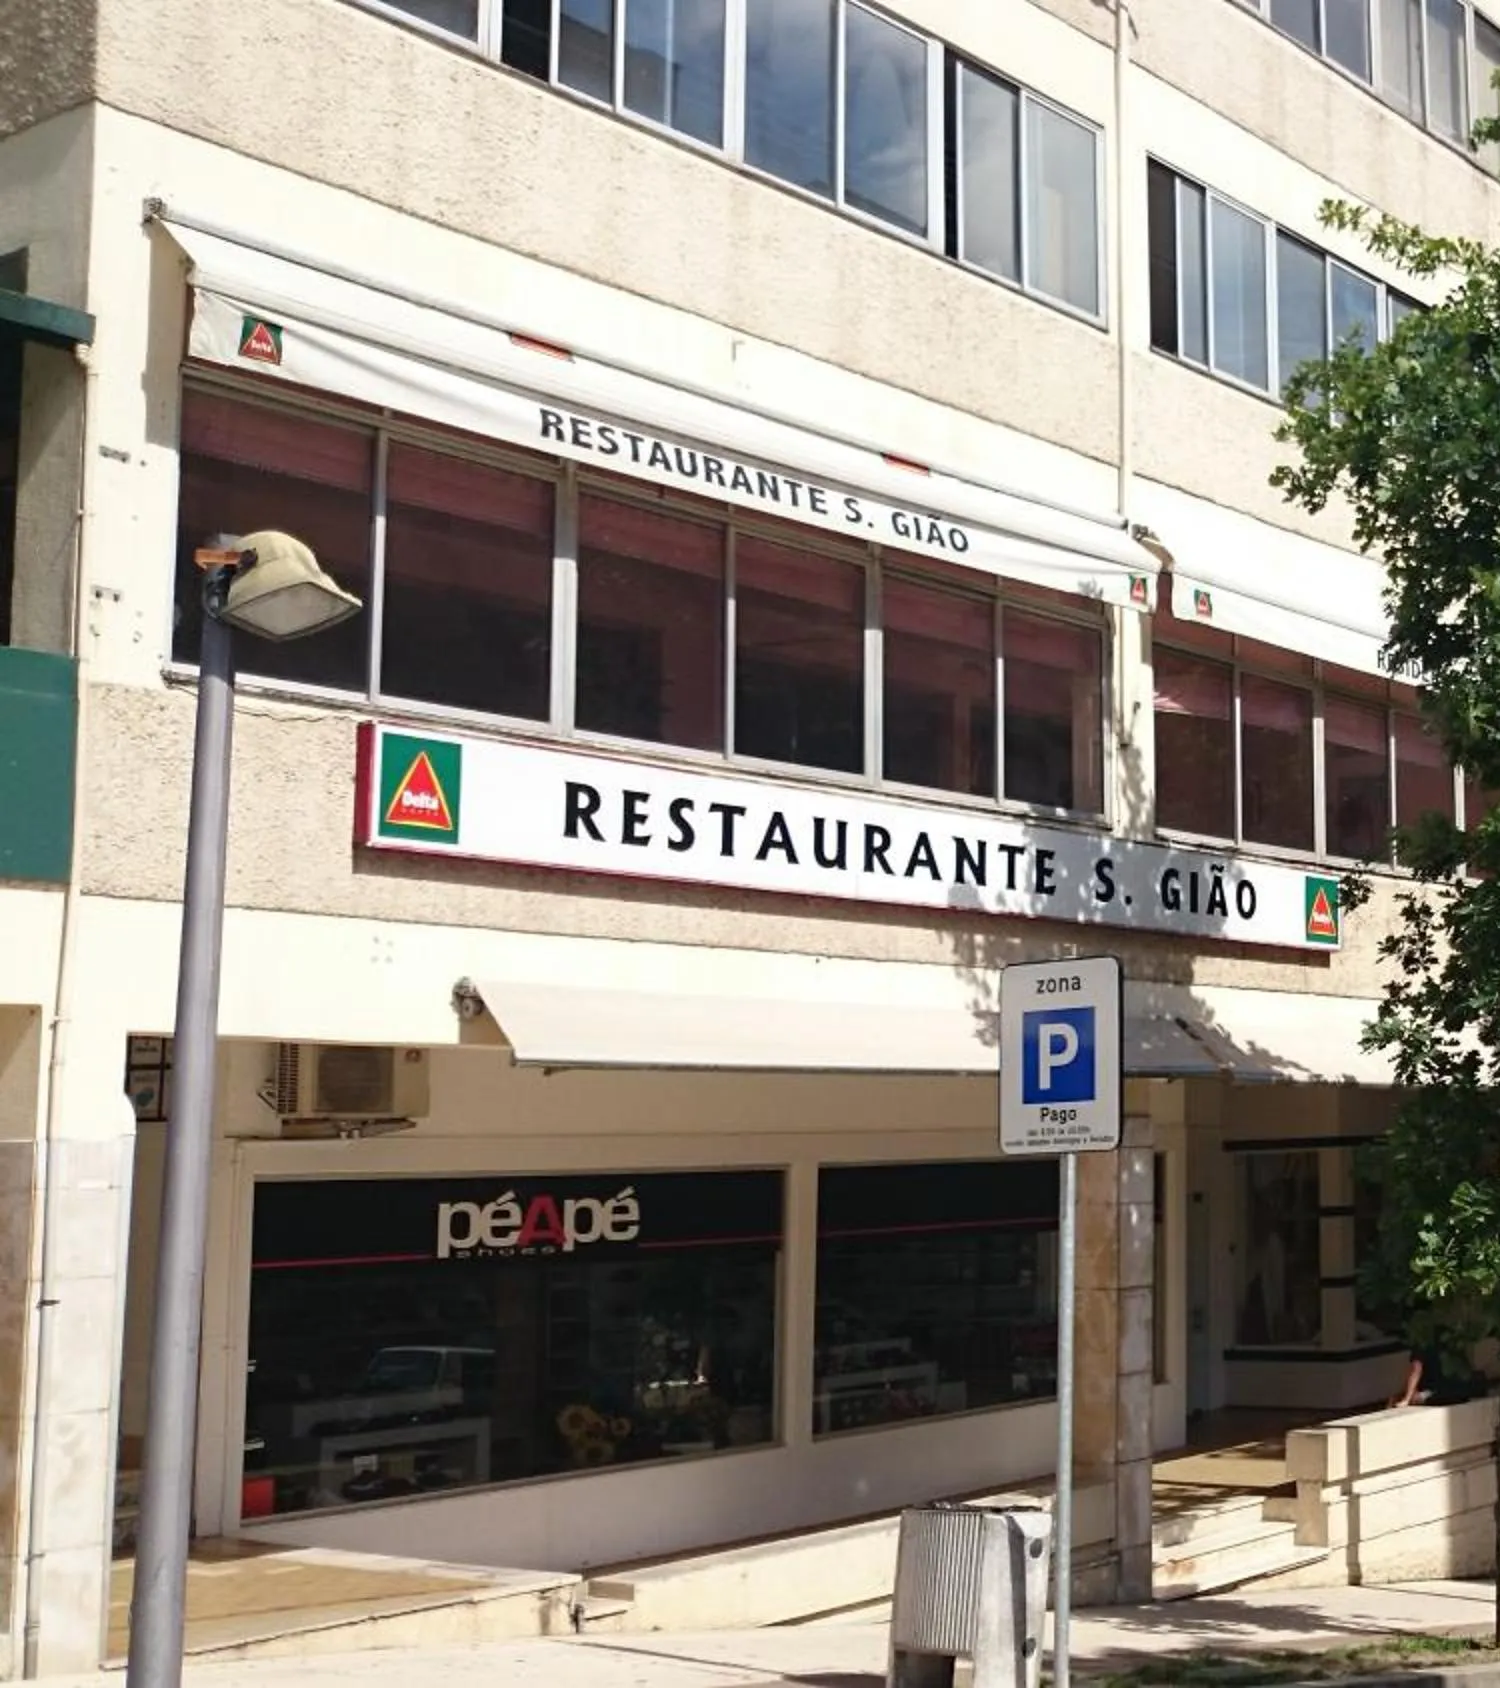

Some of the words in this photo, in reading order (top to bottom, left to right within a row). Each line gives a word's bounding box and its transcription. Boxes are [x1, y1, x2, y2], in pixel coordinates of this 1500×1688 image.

[539, 408, 829, 515] RESTAURANTE
[843, 497, 875, 528] S.
[891, 510, 969, 553] GIÃO
[562, 781, 1057, 896] RESTAURANTE
[1094, 858, 1133, 906] S.
[1160, 864, 1258, 920] GIÃO
[1036, 975, 1081, 994] zona
[1038, 1023, 1079, 1090] P
[1040, 1106, 1077, 1124] Pago
[437, 1186, 640, 1259] péApé
